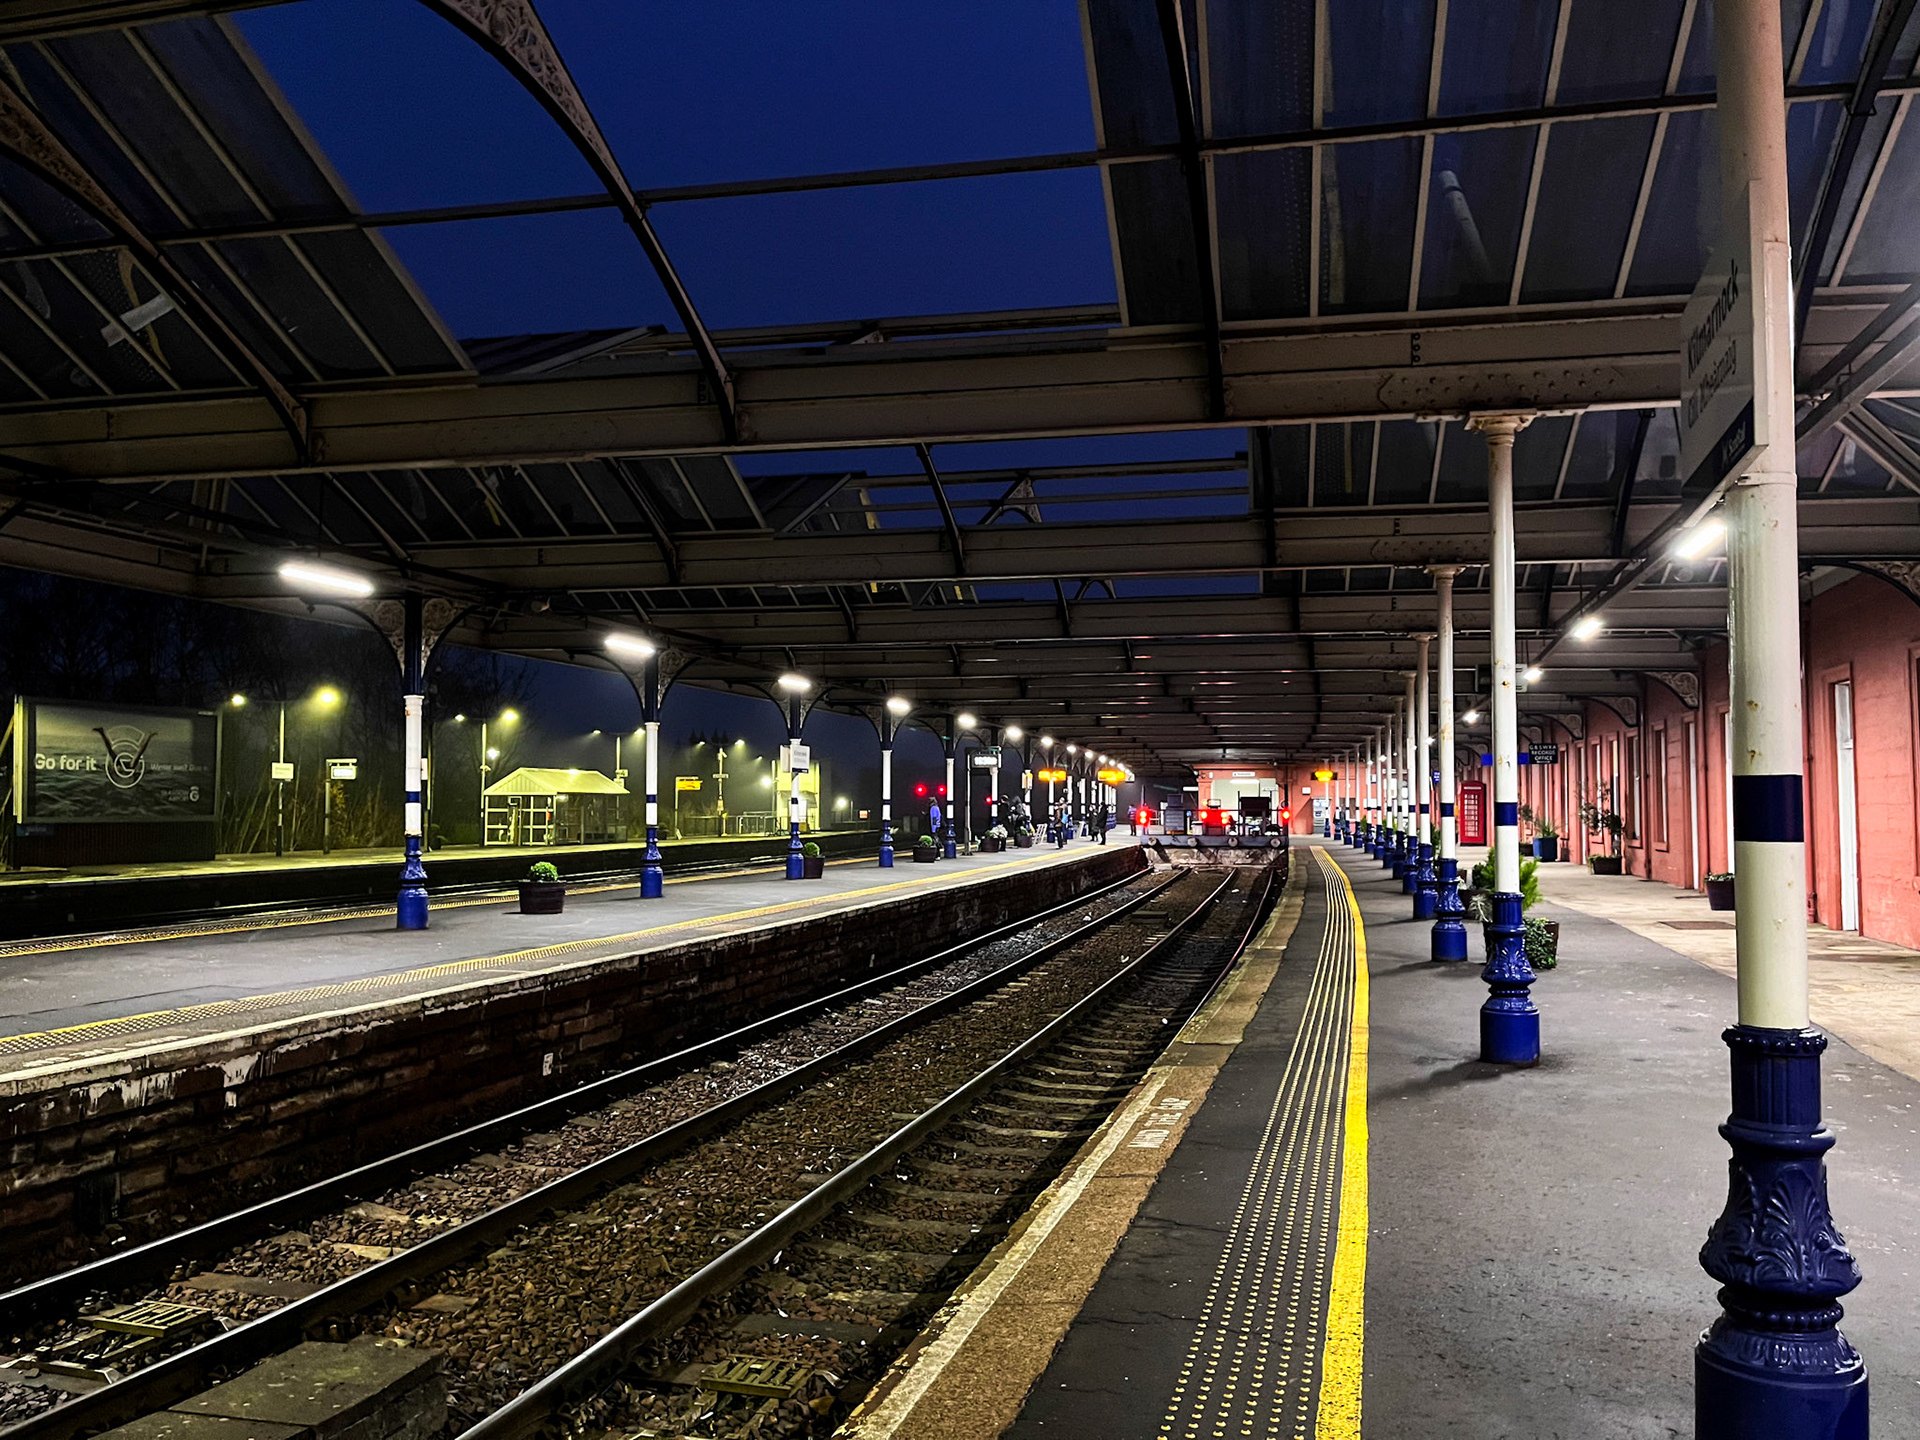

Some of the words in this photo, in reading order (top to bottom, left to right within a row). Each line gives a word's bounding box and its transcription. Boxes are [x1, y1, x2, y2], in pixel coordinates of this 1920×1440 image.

[1687, 257, 1739, 379] Kilmarnock
[35, 753, 56, 770] Go
[60, 754, 82, 771] for
[86, 755, 97, 771] it
[1144, 1112, 1183, 1126] THE
